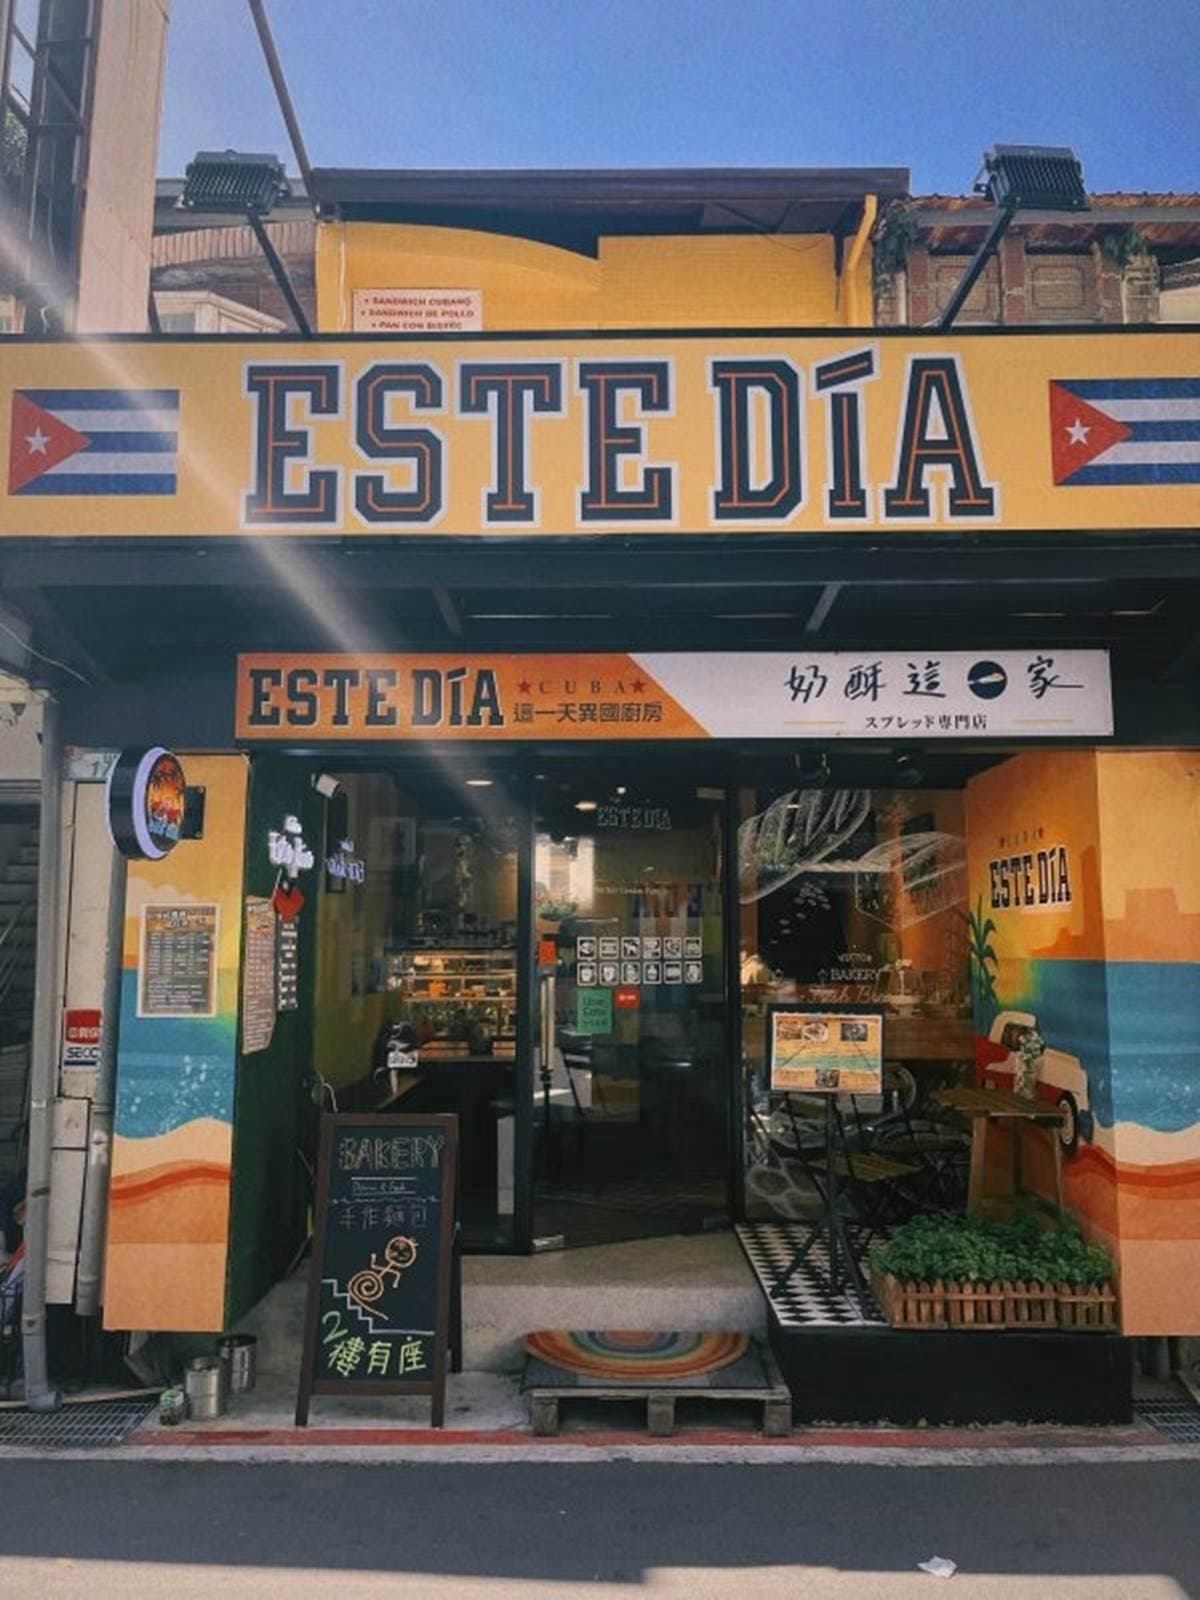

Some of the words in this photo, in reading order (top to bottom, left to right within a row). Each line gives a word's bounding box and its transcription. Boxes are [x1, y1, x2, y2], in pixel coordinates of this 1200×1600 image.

[373, 297, 426, 306] SANDWICH
[428, 297, 471, 306] CUBANO
[369, 309, 423, 318] SANDWICH
[441, 309, 474, 318] POLLO
[244, 359, 676, 525] ESTE
[248, 667, 399, 727] ESTE
[538, 680, 627, 695] CUBA
[512, 701, 663, 724] 這一天異國廚房
[864, 713, 988, 730] スプレッド専門店
[988, 852, 1035, 909] ESTE
[338, 1134, 445, 1171] BAKERY
